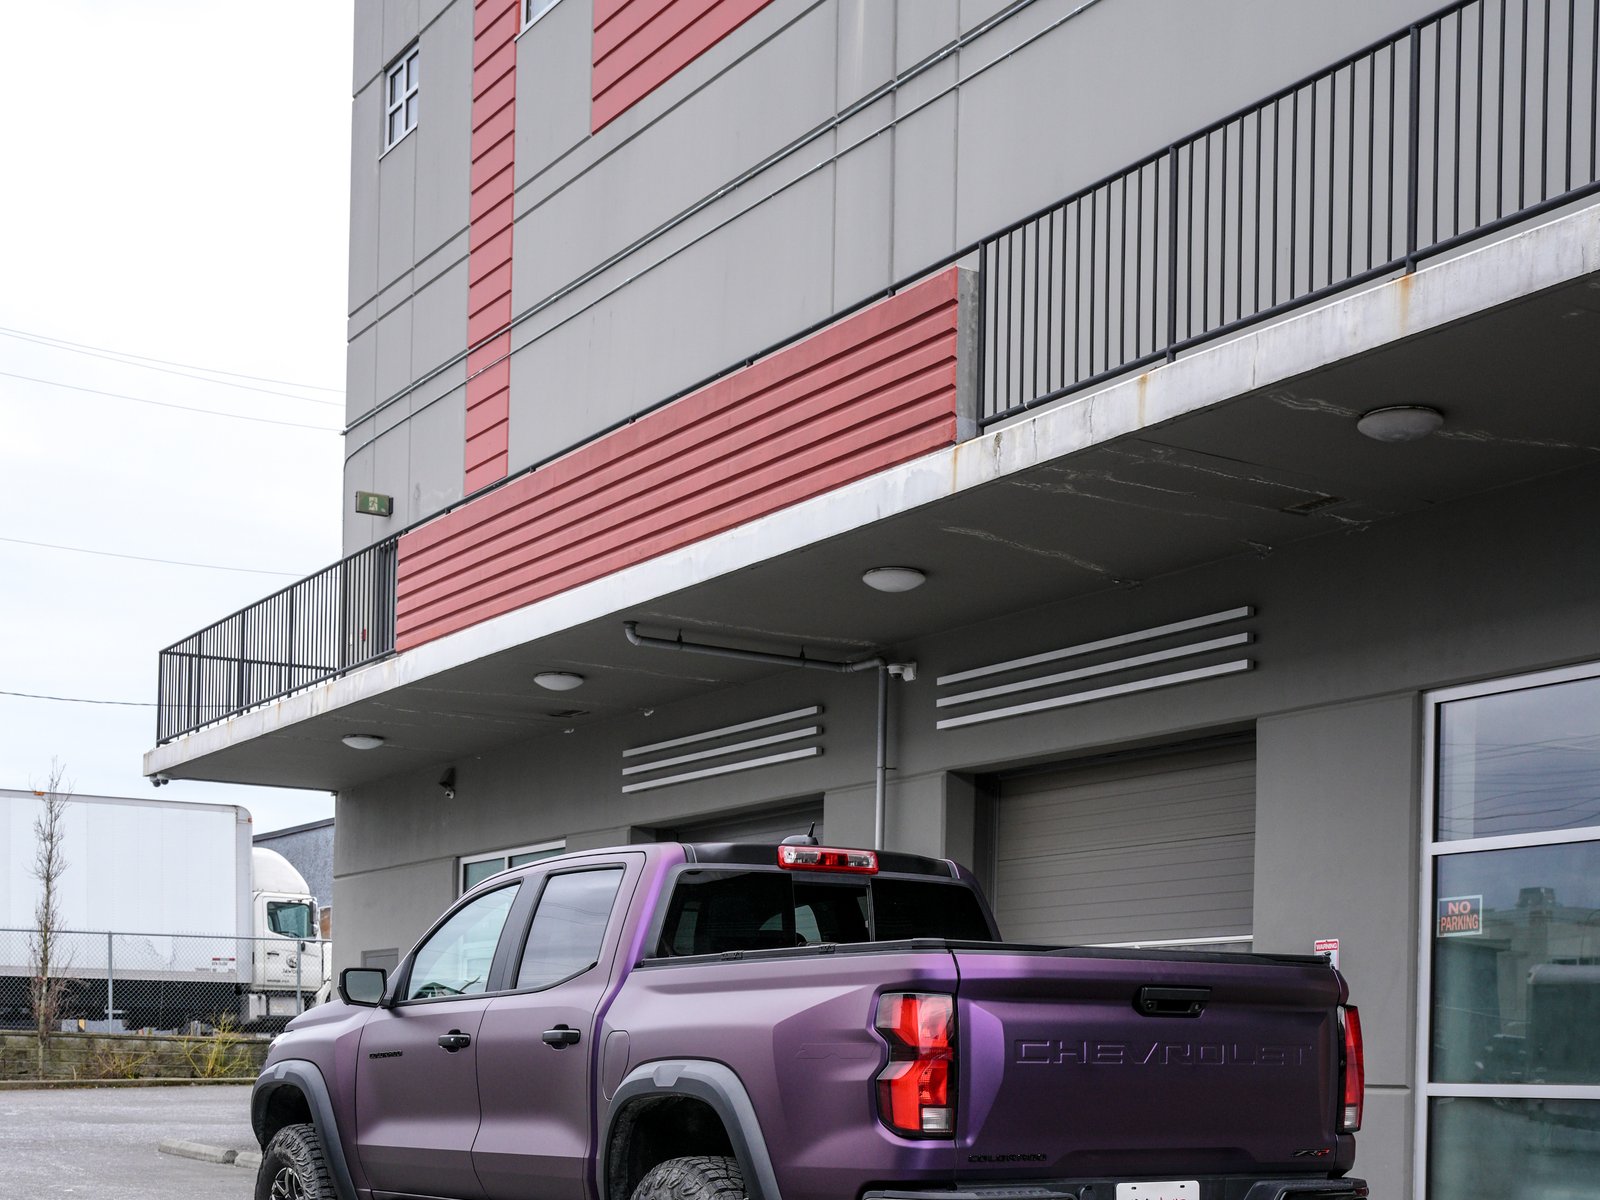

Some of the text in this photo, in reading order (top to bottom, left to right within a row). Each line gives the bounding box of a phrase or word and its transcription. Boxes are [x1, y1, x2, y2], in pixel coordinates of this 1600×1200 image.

[1448, 901, 1471, 915] NO
[1440, 914, 1479, 931] PARKING
[1014, 1040, 1313, 1066] CHEVROLET
